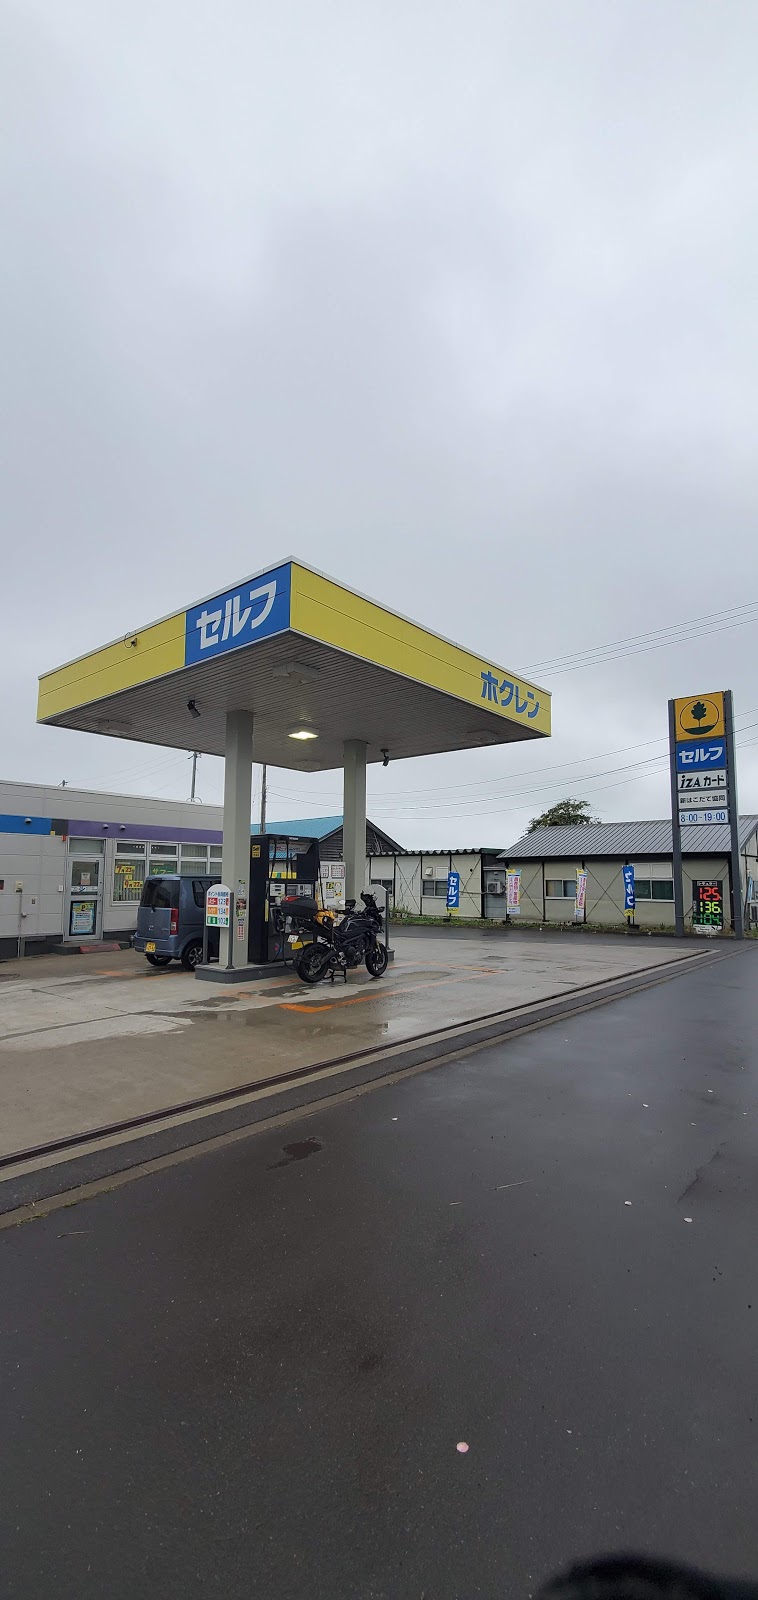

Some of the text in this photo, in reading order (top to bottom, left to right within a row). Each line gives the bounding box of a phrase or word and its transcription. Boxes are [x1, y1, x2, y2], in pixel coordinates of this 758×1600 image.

[196, 580, 277, 649] セルフ
[480, 670, 540, 718] ホクレン
[679, 746, 723, 763] セルフ
[703, 775, 725, 787] カード
[448, 876, 458, 905] セルフ
[699, 887, 720, 901] 125
[700, 901, 721, 913] 136
